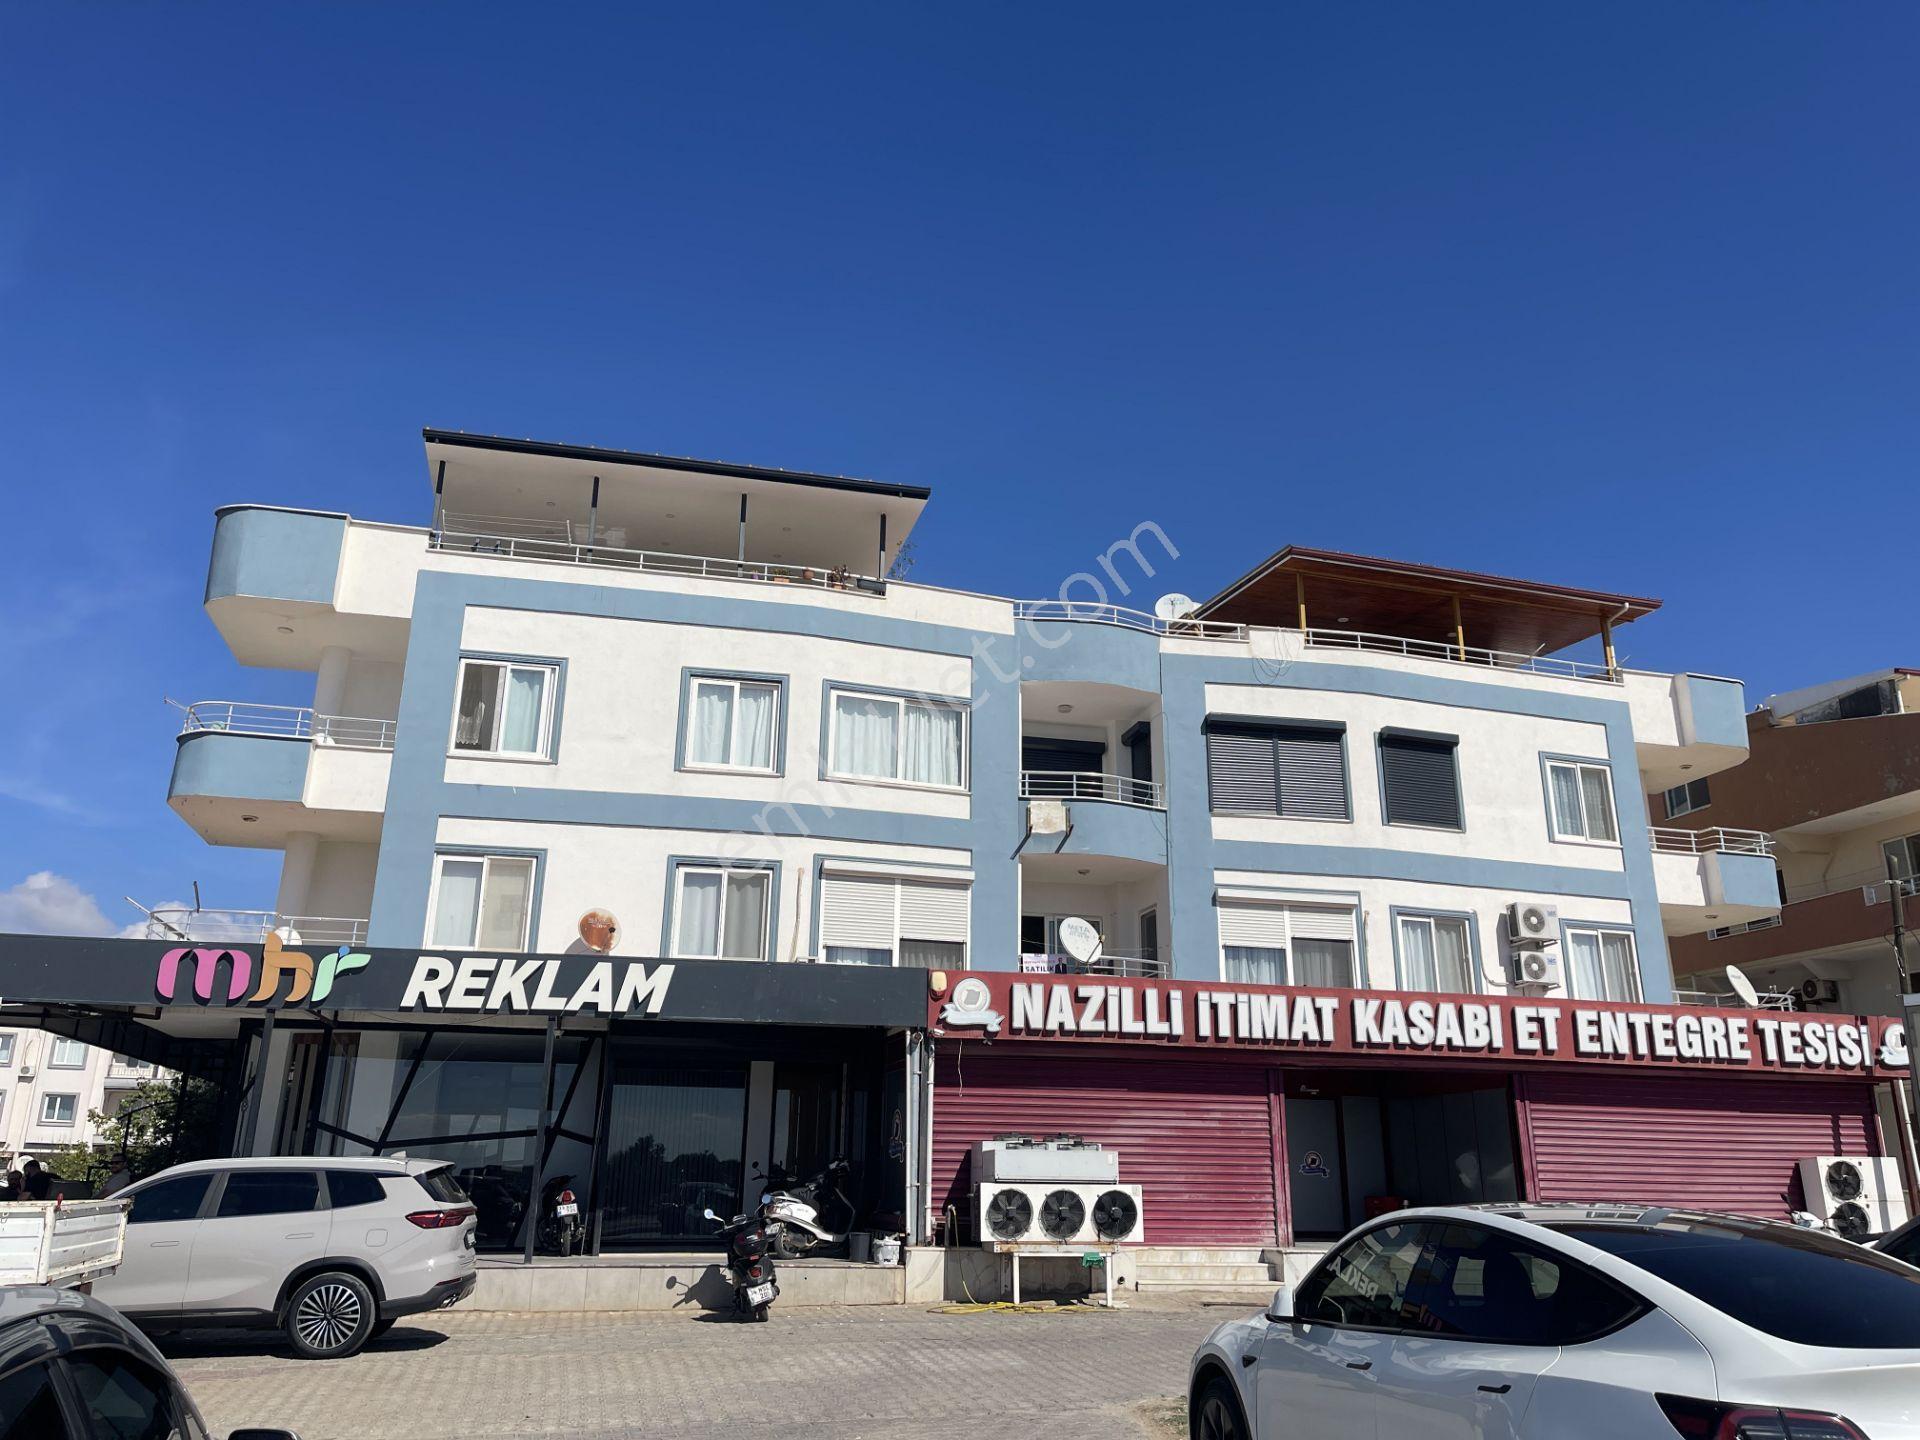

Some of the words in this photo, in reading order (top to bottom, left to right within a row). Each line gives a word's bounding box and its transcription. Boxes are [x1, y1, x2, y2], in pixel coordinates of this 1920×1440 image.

[157, 931, 371, 1002] mhr
[400, 956, 675, 1012] REKLAM
[1353, 998, 1503, 1049] KASABI
[1514, 1006, 1561, 1050] ET
[1575, 1009, 1751, 1060] ENTEGRE
